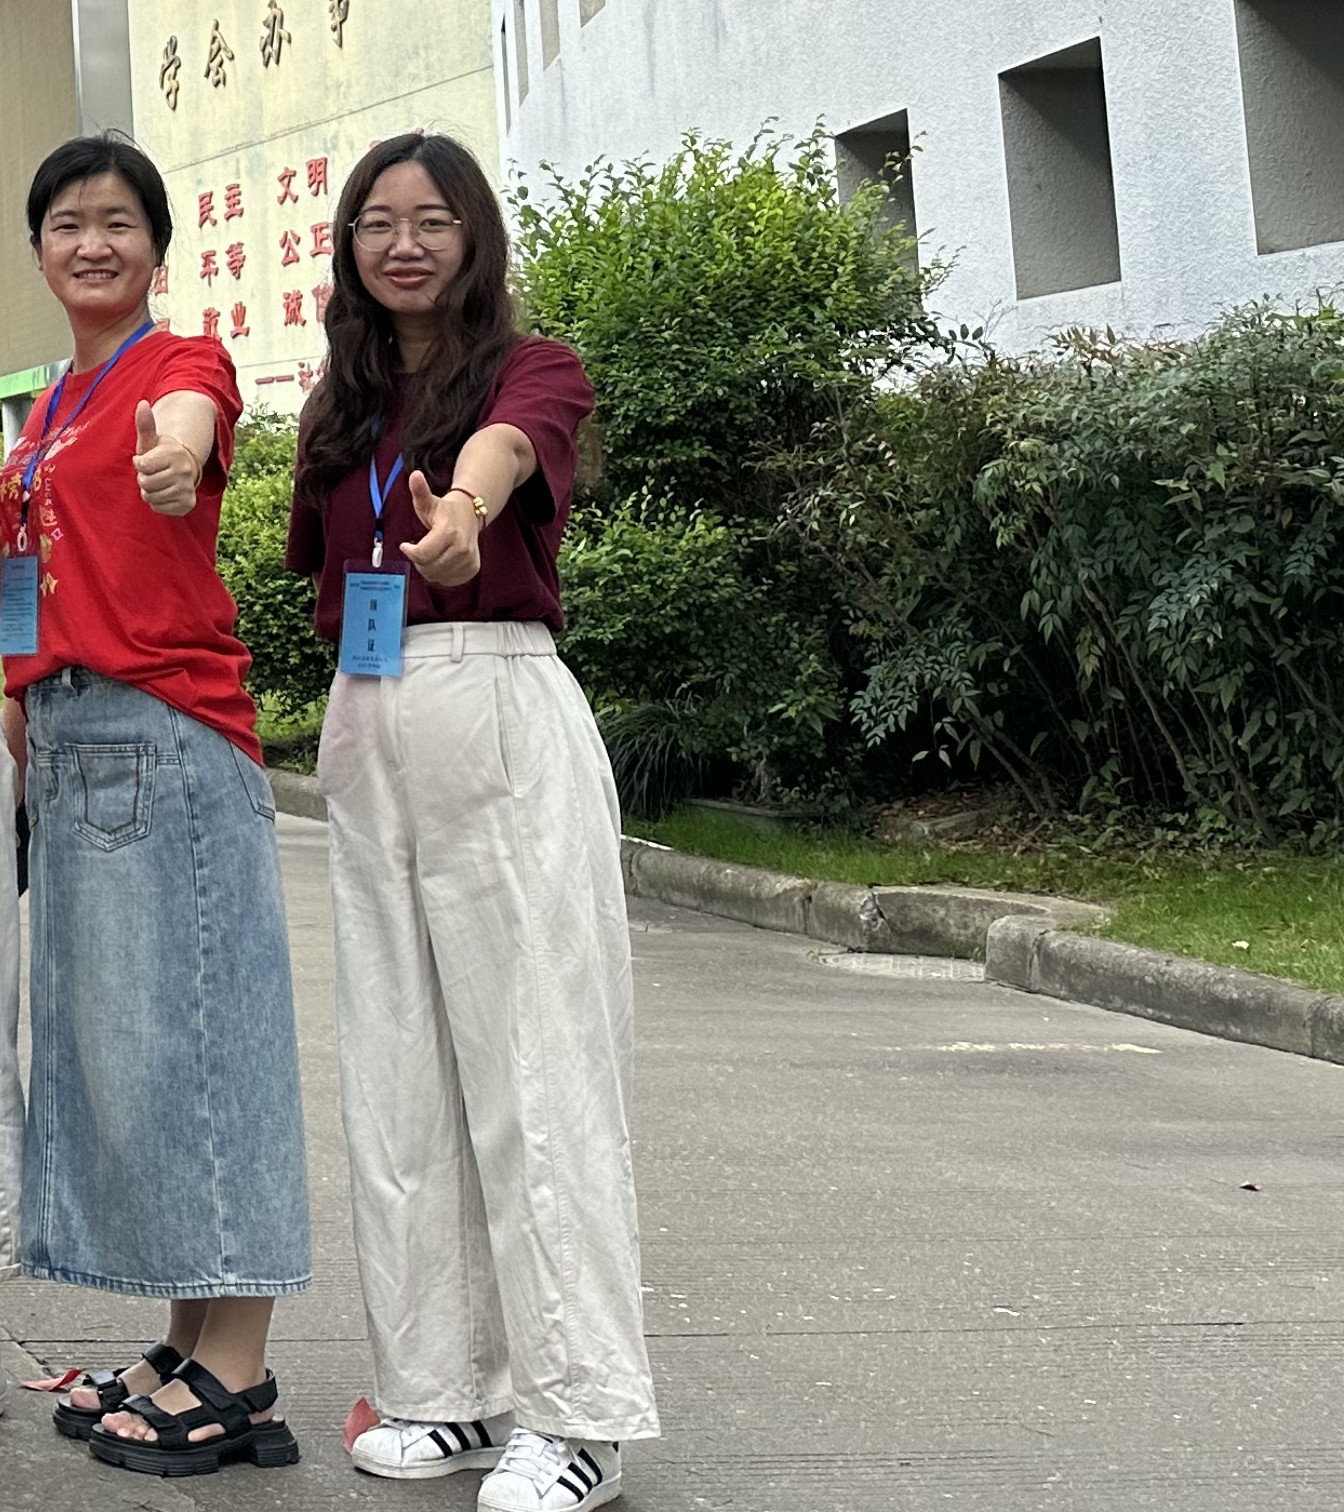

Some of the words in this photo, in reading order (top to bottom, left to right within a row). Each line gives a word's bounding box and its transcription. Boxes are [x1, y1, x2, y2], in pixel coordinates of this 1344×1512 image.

[197, 182, 245, 229] 民主
[276, 156, 329, 206] 文明
[199, 241, 247, 288] 平等
[278, 221, 333, 267] 公正
